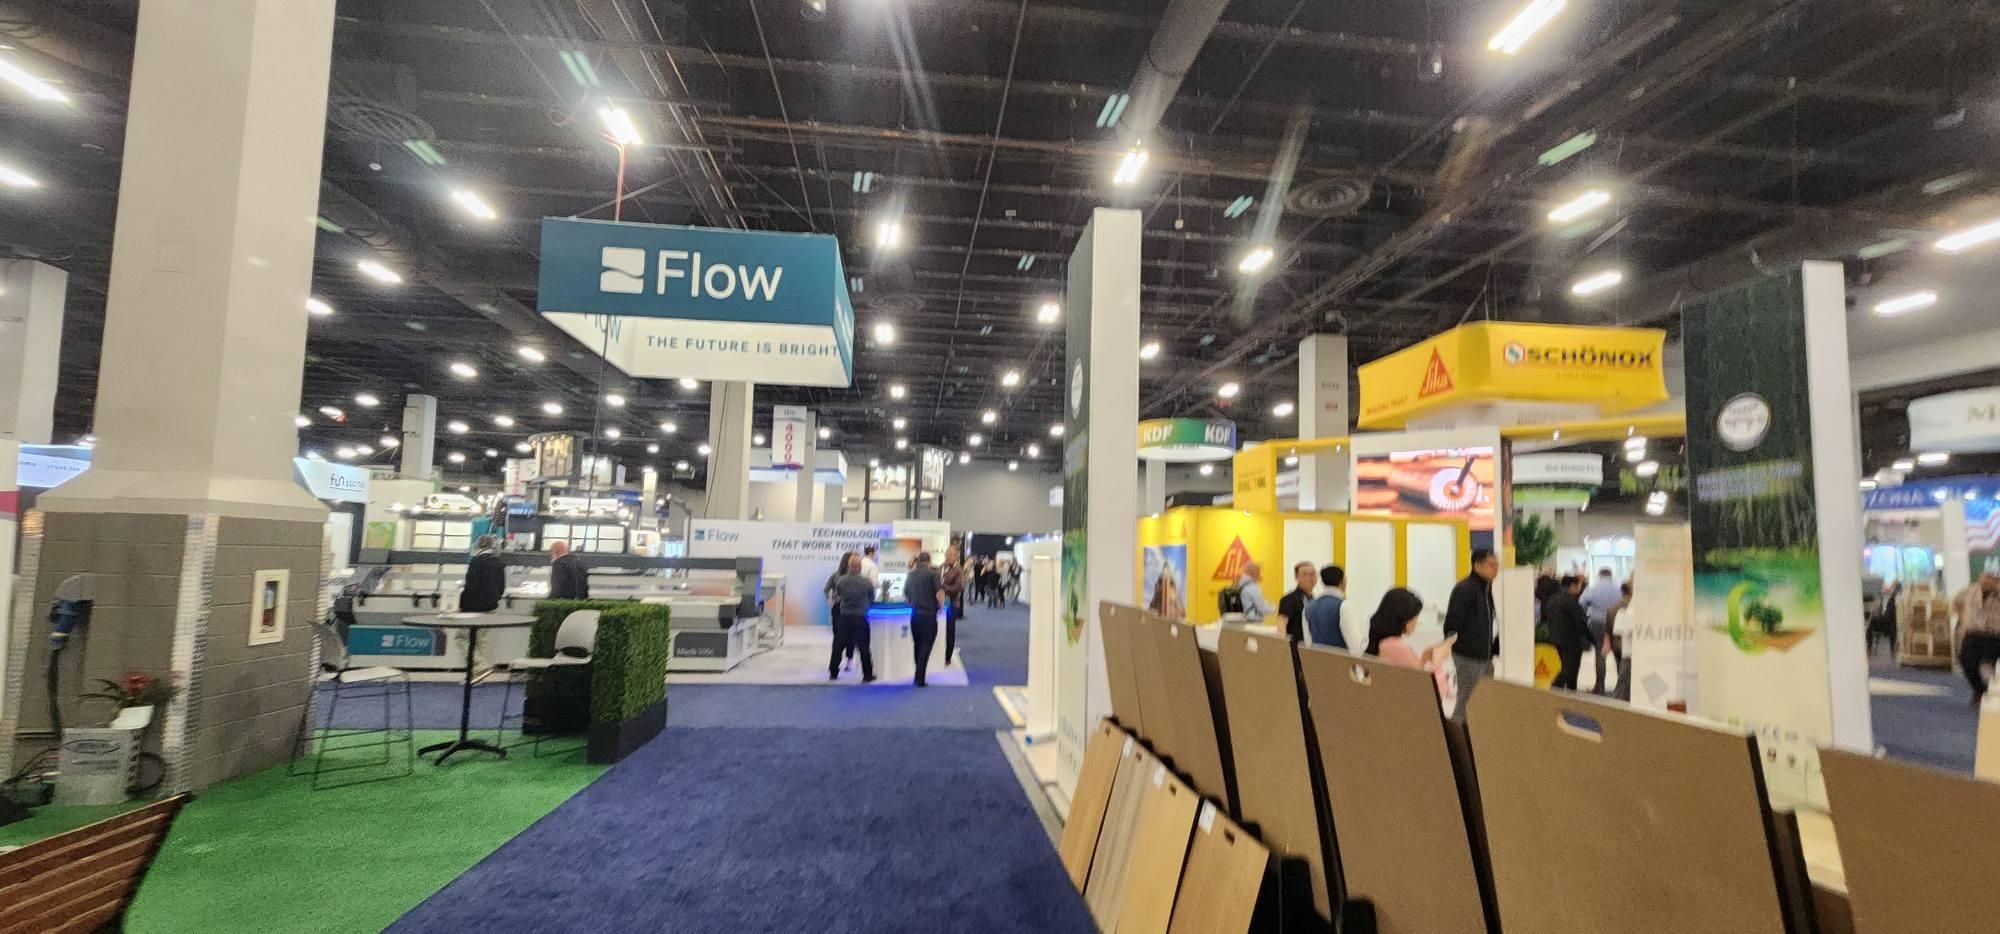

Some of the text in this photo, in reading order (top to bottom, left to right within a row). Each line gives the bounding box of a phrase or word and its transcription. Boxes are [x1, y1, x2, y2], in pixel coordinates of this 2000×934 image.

[656, 249, 783, 301] Flow
[646, 335, 679, 349] THE
[685, 338, 750, 353] FUTURE
[756, 341, 772, 353] IS
[1528, 343, 1654, 369] SCHÖNOX
[1144, 424, 1173, 443] KDF
[707, 528, 740, 541] Flow
[772, 540, 799, 550] THAT
[801, 540, 832, 551] WORK
[396, 634, 431, 649] Flow
